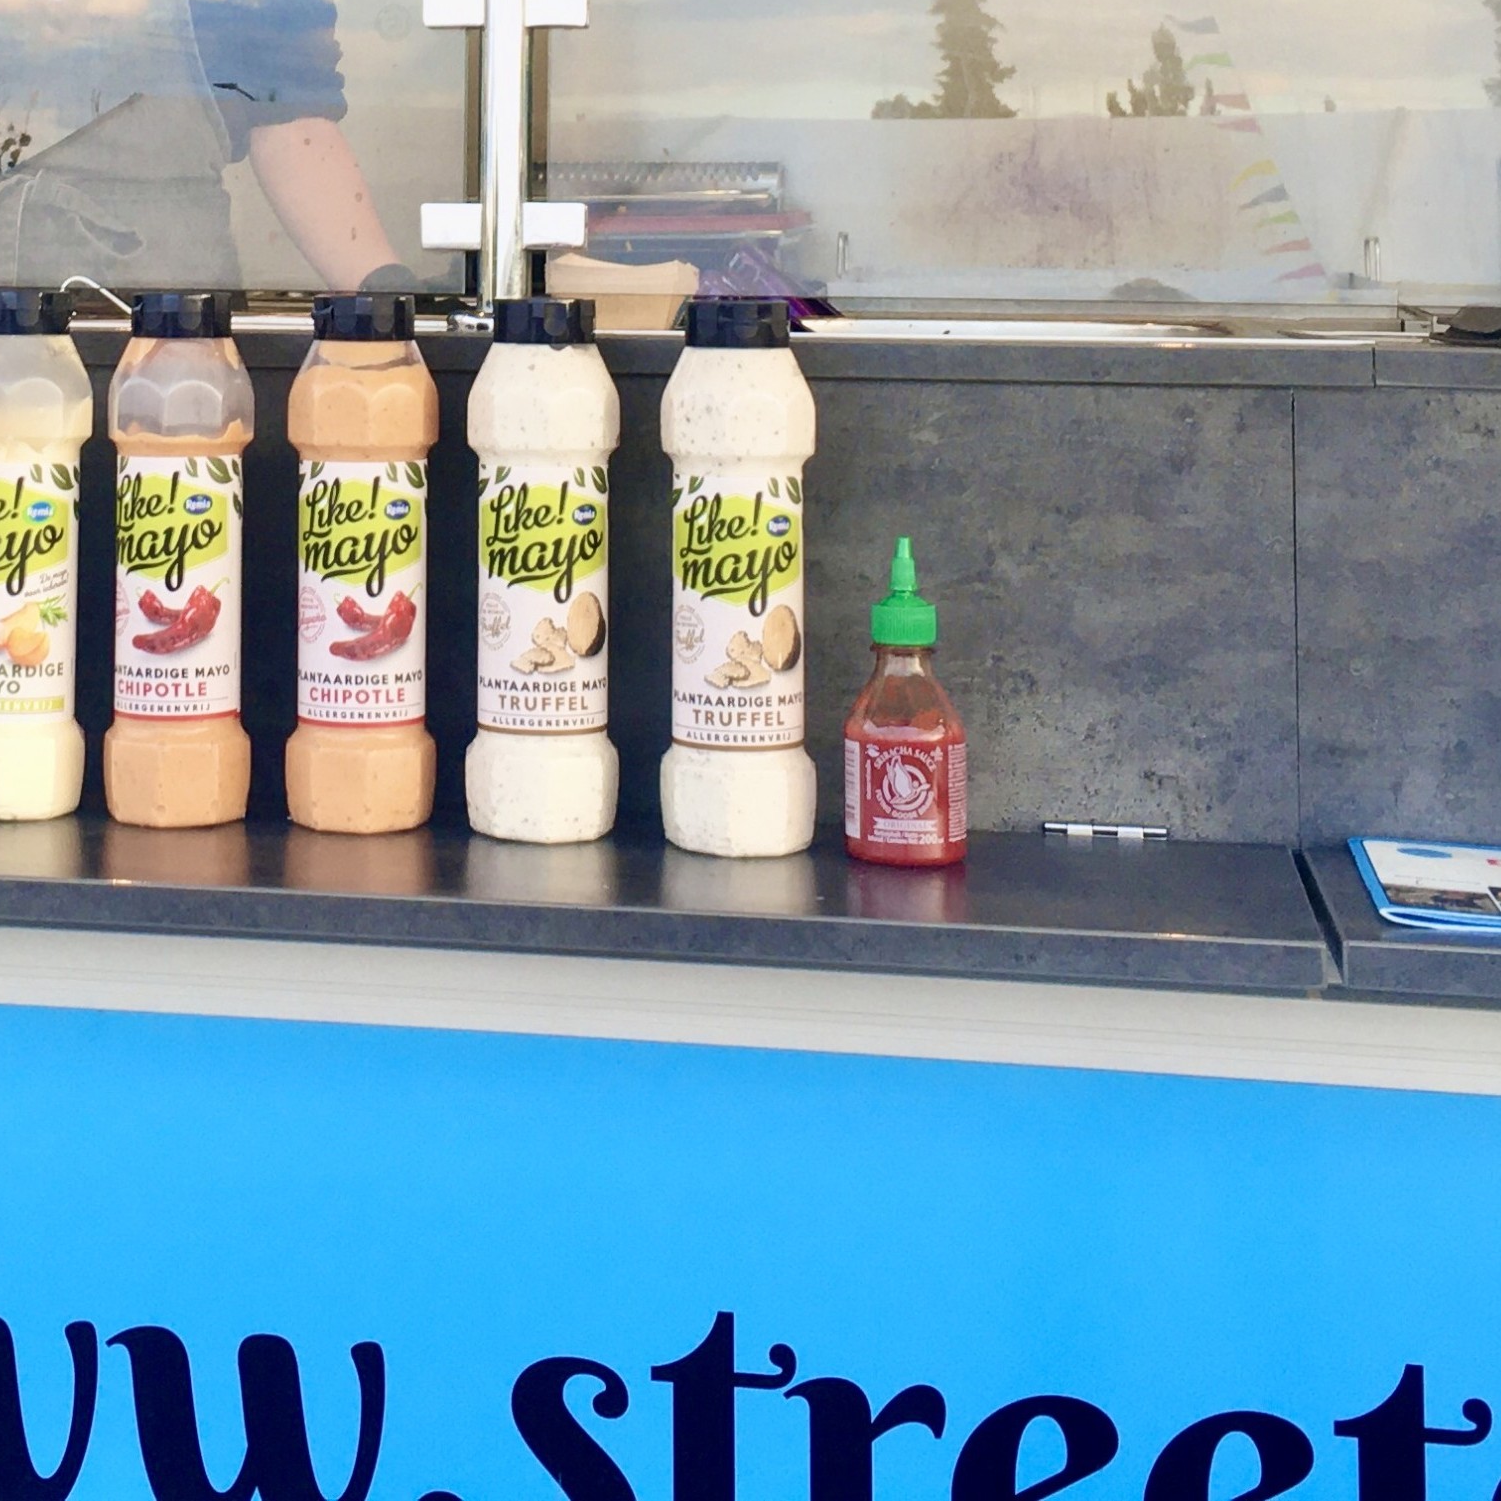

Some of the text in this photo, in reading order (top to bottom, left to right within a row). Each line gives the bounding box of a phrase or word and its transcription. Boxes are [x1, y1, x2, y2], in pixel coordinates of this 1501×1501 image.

[115, 471, 180, 532] Like!
[303, 475, 380, 540] Like!
[485, 480, 569, 548] Like!
[679, 491, 763, 559] Like!
[116, 518, 223, 592] mayo
[304, 523, 418, 598] mayo
[487, 528, 603, 604] mayo
[681, 540, 798, 618] mayo
[195, 664, 230, 678] MAYO
[394, 669, 423, 684] MAYO
[117, 679, 207, 698] CHIPOTLE
[309, 686, 406, 705] CHIPOTLE
[498, 694, 589, 712] TRUFFEL
[307, 708, 408, 719] ALLERGENENVRIJ
[491, 715, 595, 728] ALLERGENENVRIJ
[692, 708, 785, 727] TRUFFEL
[686, 731, 791, 743] ALLERGENENVRIJ
